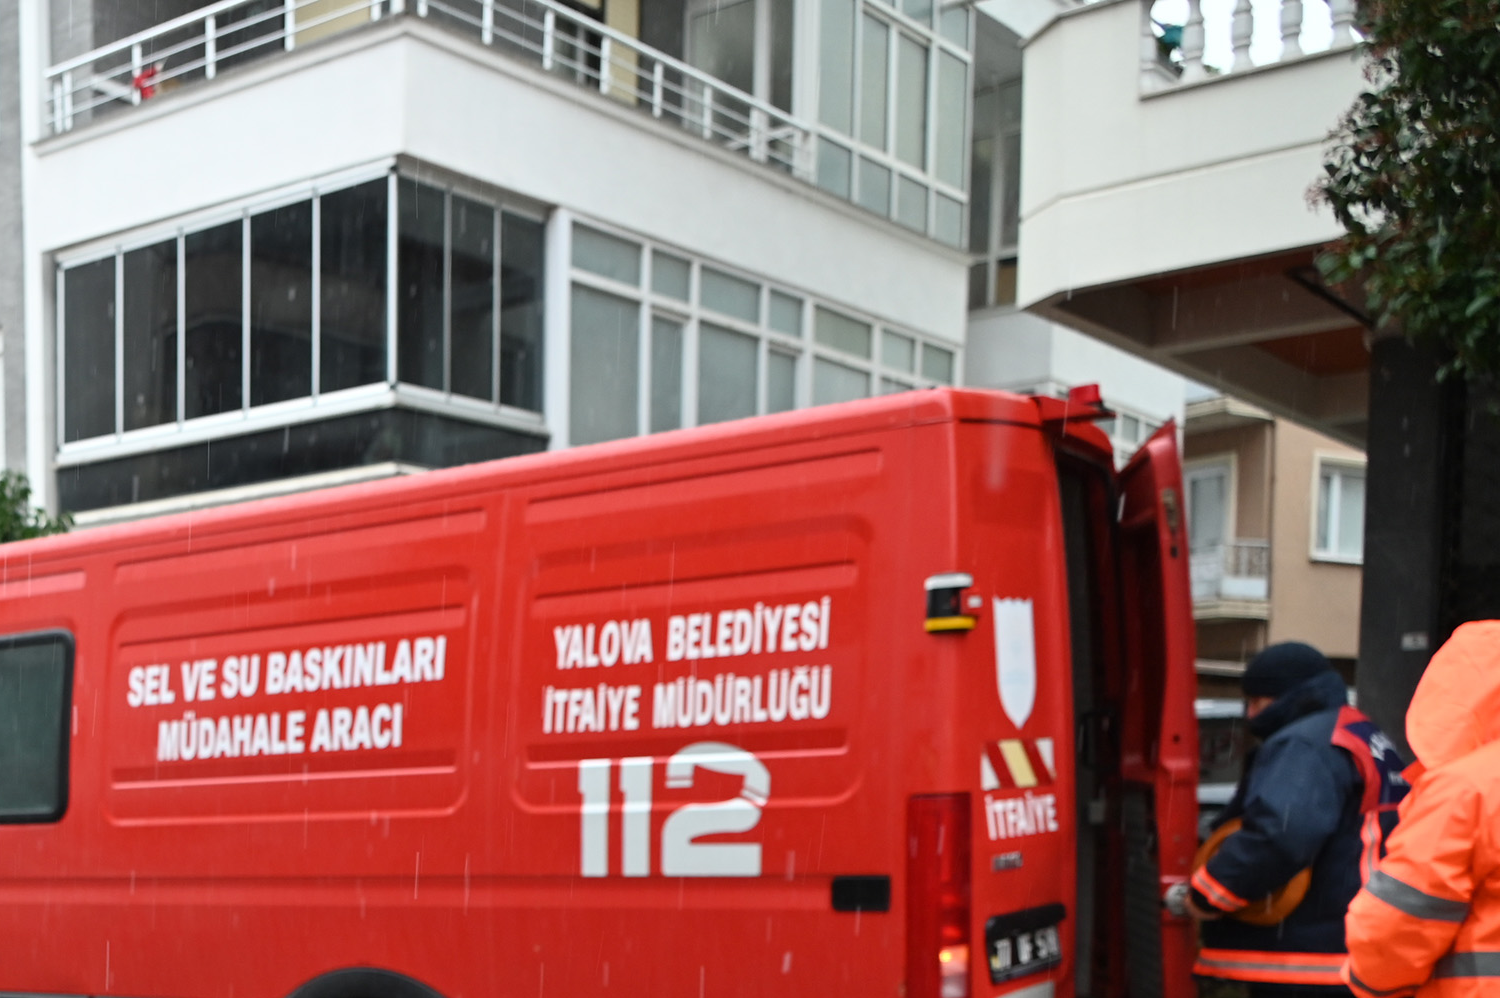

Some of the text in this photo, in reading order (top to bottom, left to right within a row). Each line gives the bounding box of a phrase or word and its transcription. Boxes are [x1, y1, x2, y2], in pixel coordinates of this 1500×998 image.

[553, 595, 832, 670] YALOVA BELEDİYESİ
[126, 635, 448, 708] SEL VE SU BASKINLARI
[542, 665, 833, 734] İTFAİYE MÜDÜRLÜĞÜ
[156, 702, 404, 763] MÜDAHALE ARACI
[578, 740, 772, 878] 112
[984, 790, 1059, 841] İTFAİYE
